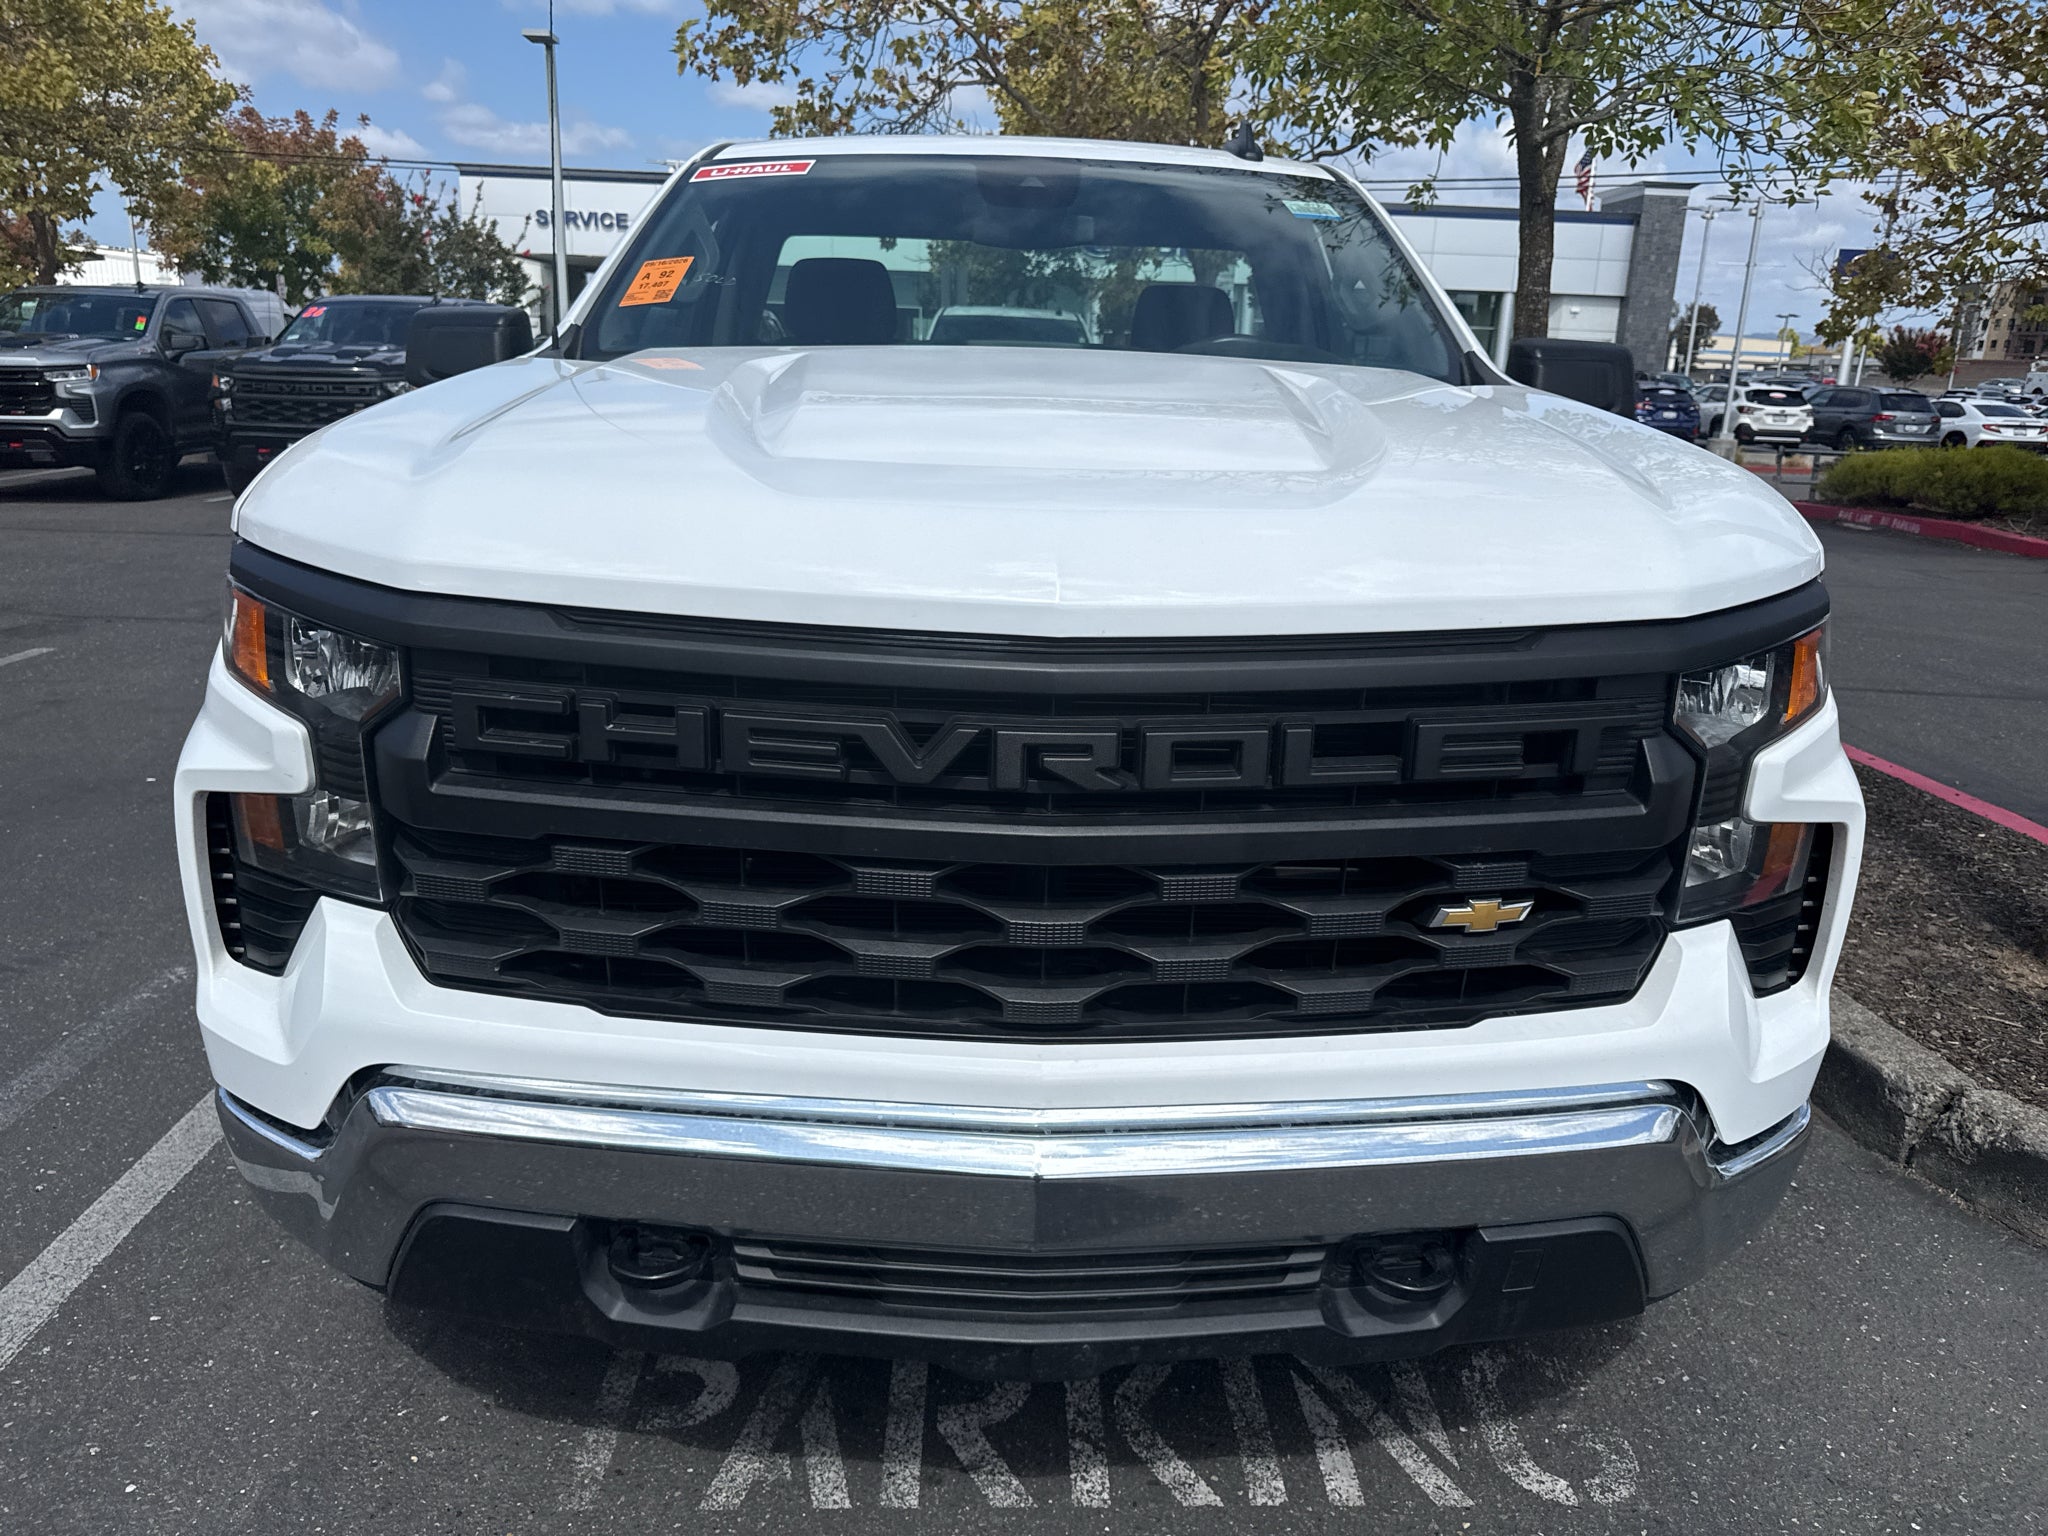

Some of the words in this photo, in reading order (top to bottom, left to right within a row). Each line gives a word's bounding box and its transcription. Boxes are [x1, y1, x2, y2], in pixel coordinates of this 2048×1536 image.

[710, 164, 792, 177] U-HAUL
[535, 209, 629, 230] SRVICE
[642, 273, 651, 281] A
[659, 270, 675, 279] 92
[451, 684, 1636, 792] CHEVROLET
[560, 1347, 1641, 1510] PARKING
